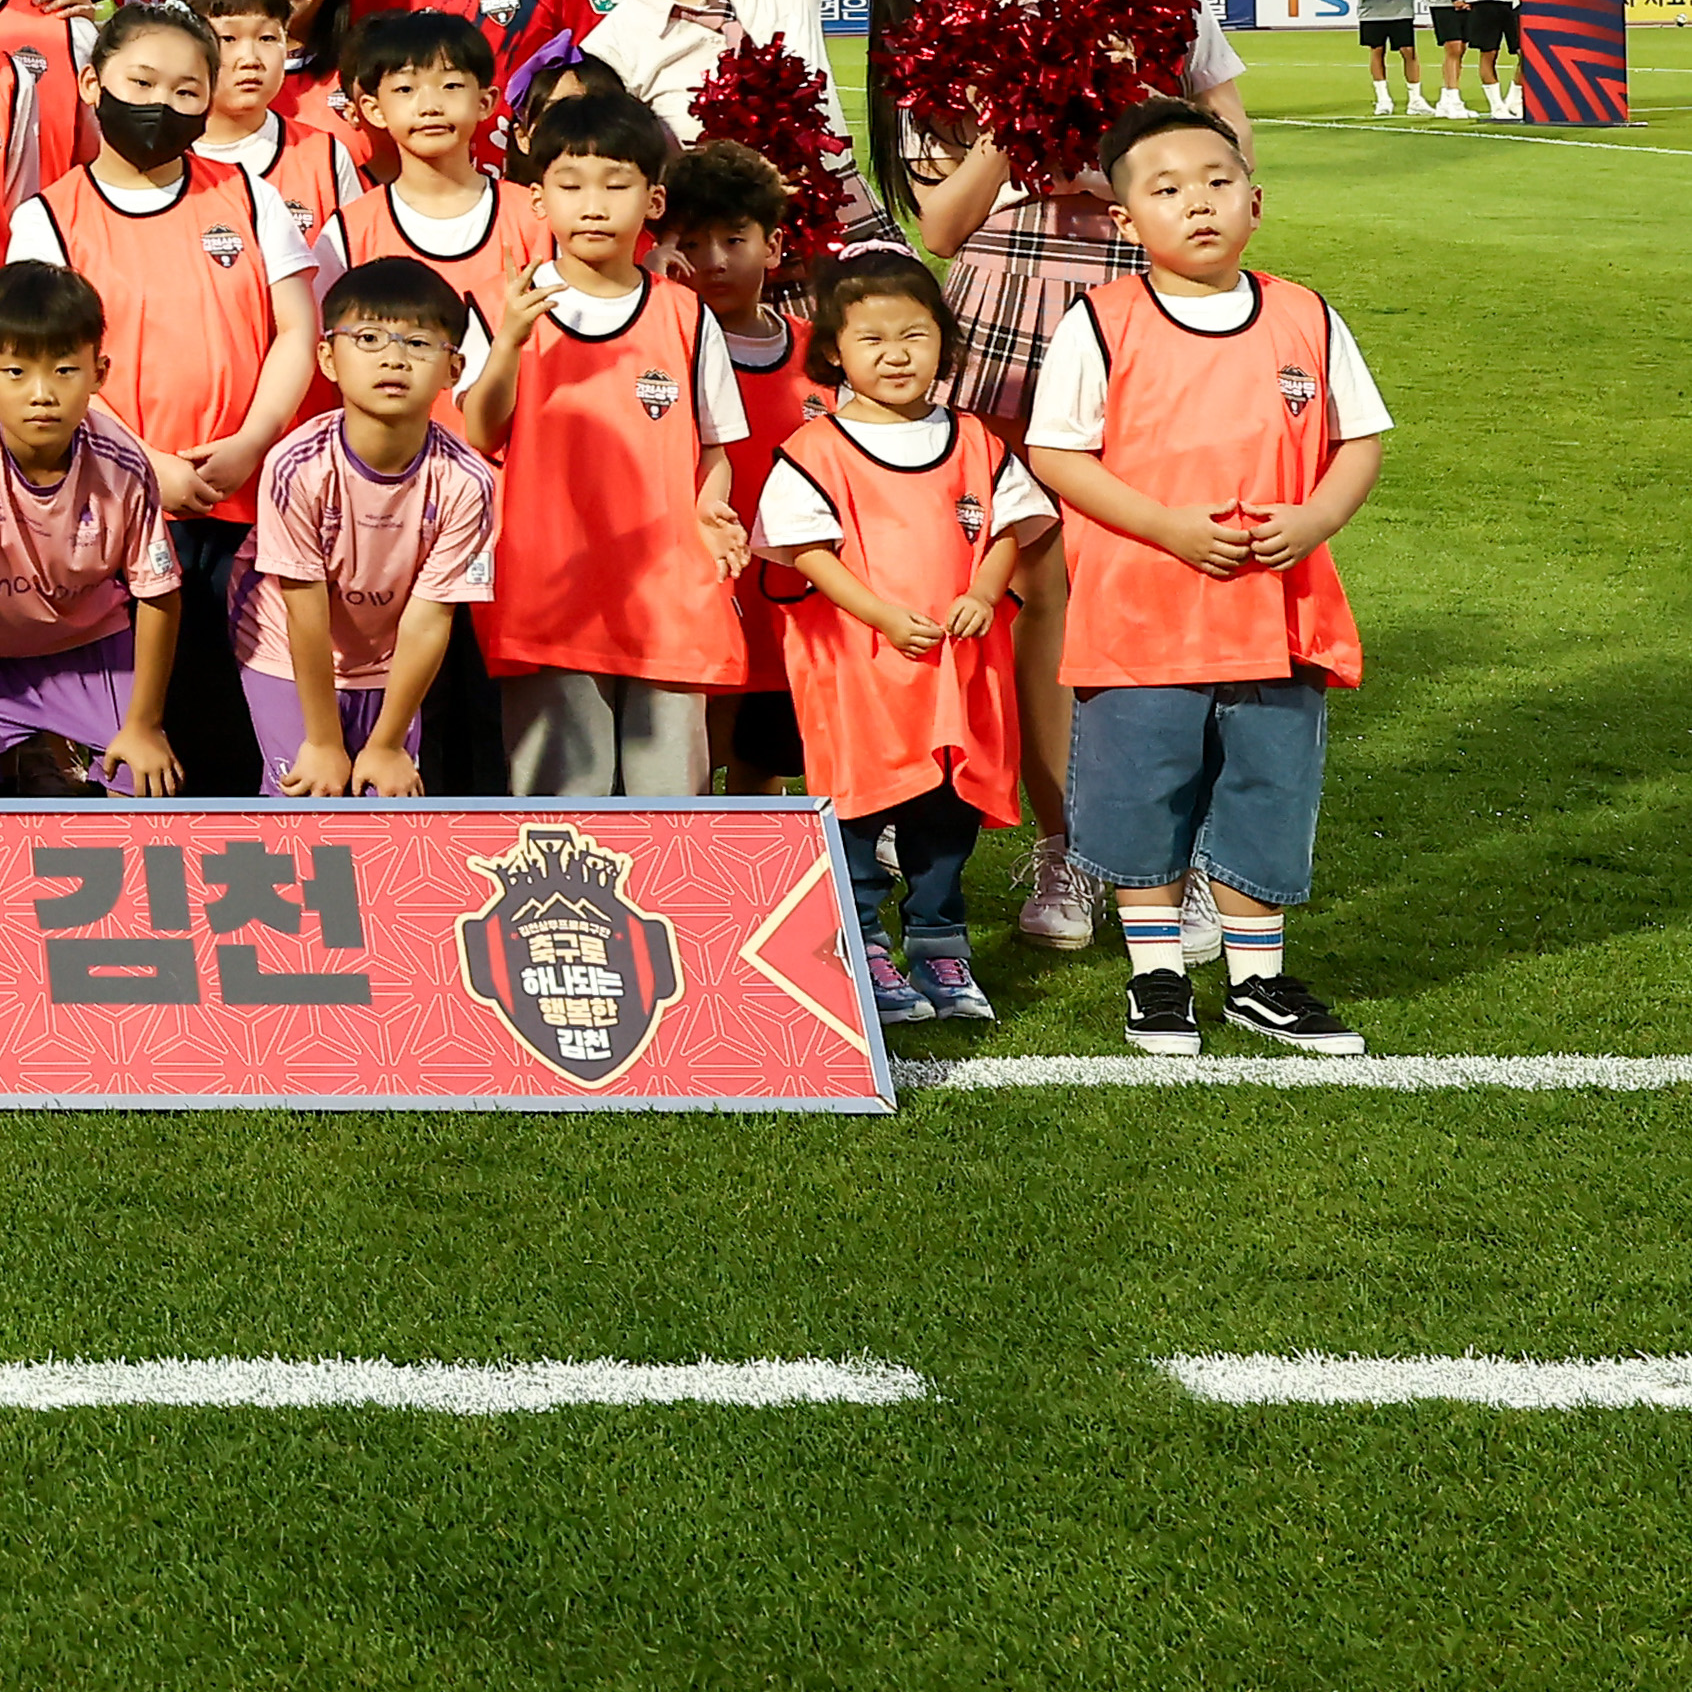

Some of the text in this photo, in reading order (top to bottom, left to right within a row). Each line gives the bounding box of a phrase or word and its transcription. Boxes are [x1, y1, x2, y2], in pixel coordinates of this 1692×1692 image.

[32, 841, 372, 1006] 김천
[528, 932, 608, 965] 축구로
[520, 964, 625, 997] 하나되는
[537, 997, 619, 1027] 행복한
[555, 1028, 613, 1060] 김천
